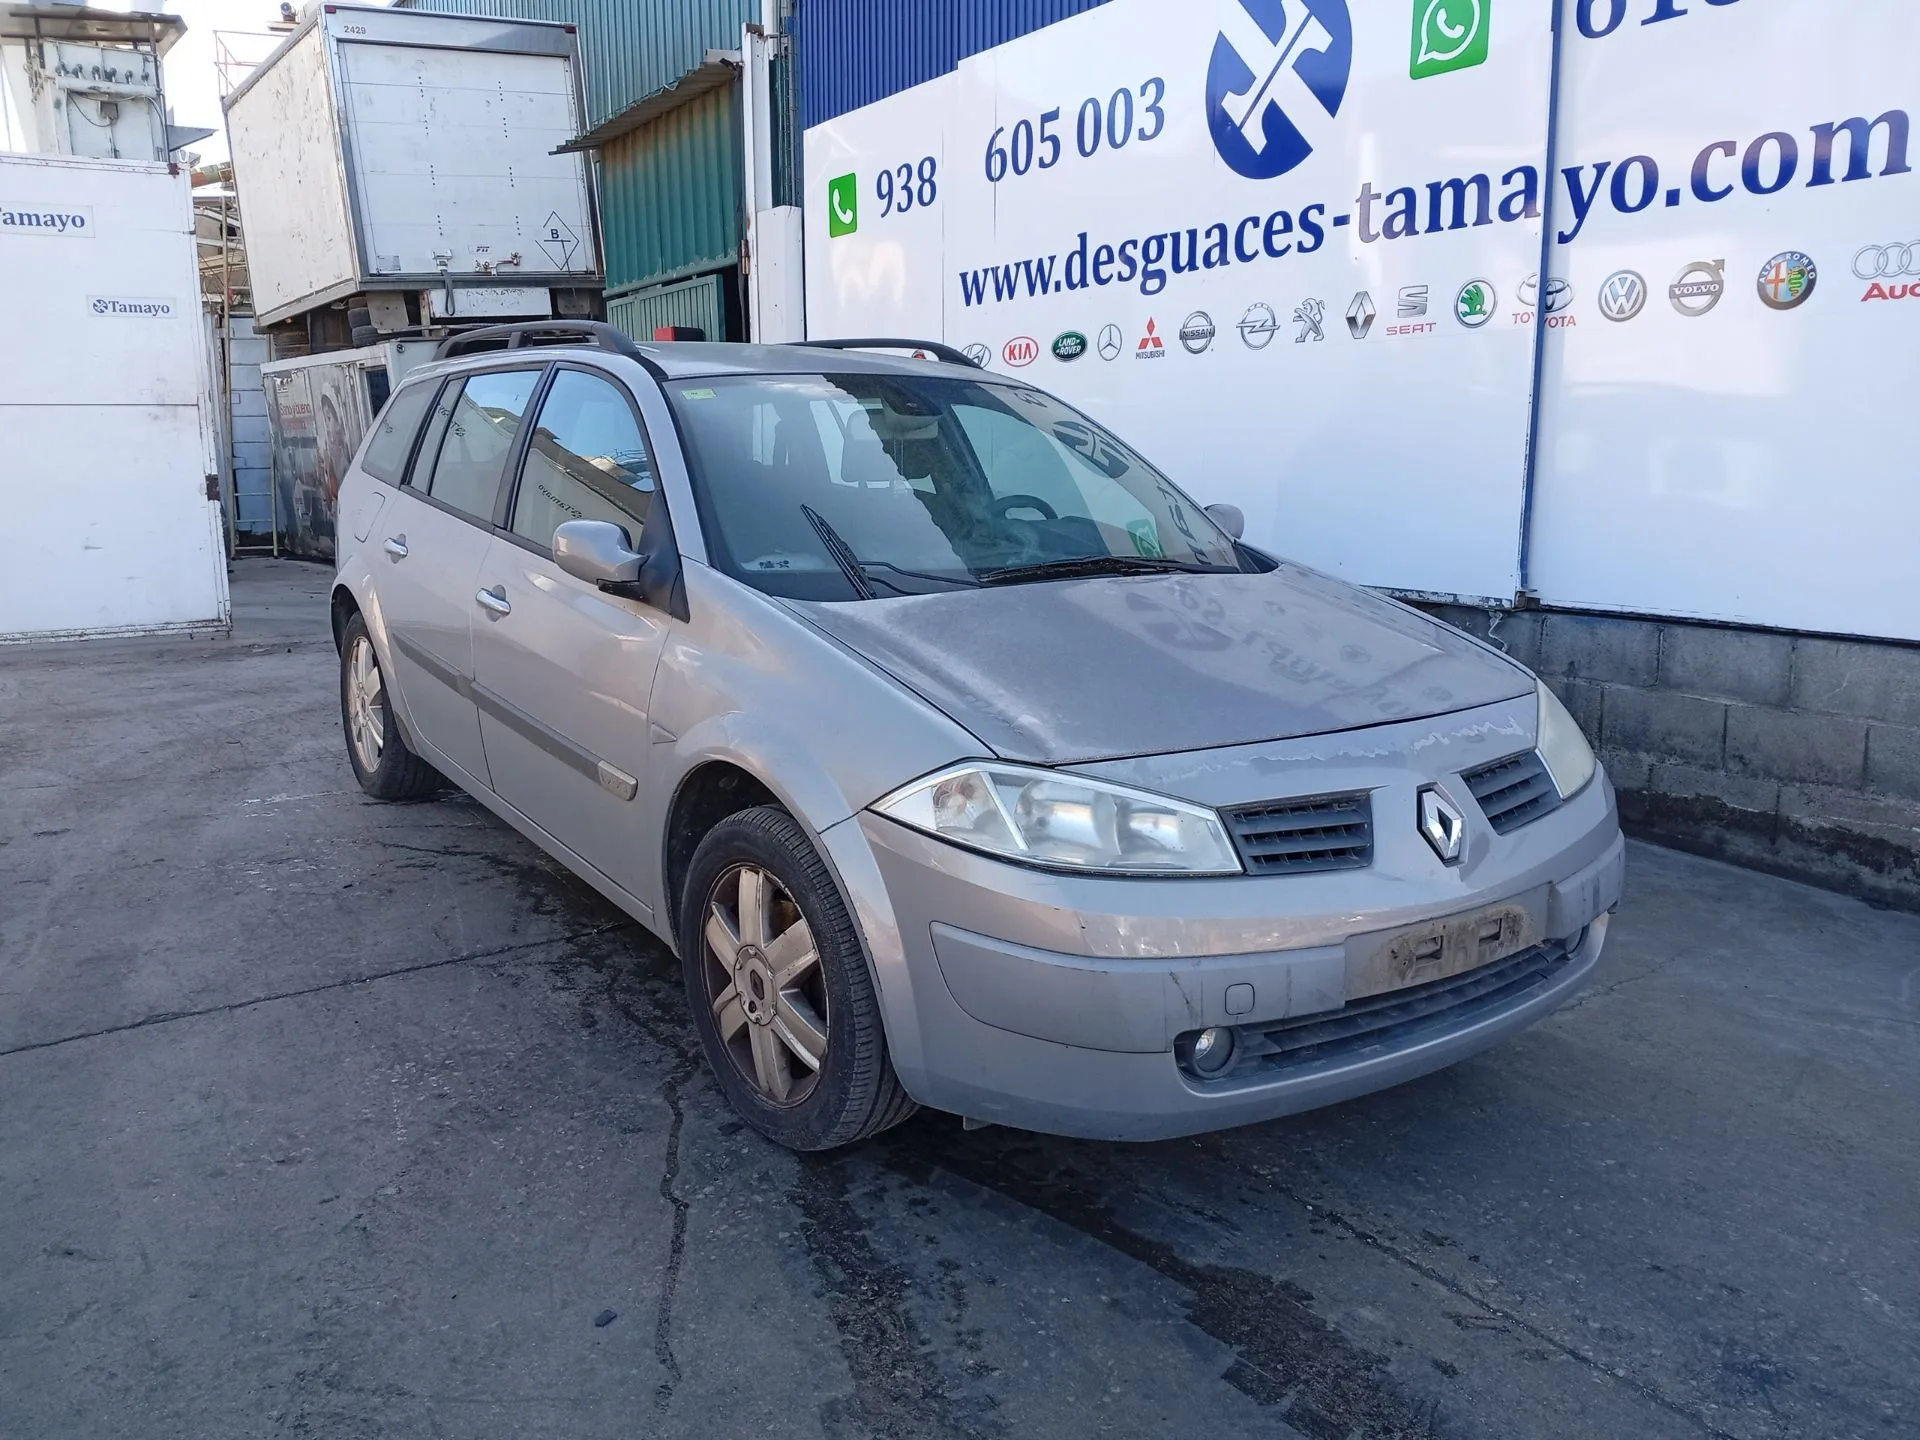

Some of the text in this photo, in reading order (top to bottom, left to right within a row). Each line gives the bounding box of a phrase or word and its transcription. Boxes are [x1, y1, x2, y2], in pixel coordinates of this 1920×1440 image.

[343, 25, 367, 35] 2429
[876, 76, 1165, 218] 938 605 003
[0, 207, 86, 232] amayo
[1785, 253, 1816, 280] ROMEO
[1672, 283, 1720, 295] VOLVO
[108, 300, 170, 317] Tamayo
[1182, 328, 1212, 338] NISSAN
[1386, 321, 1437, 336] SEAT
[1058, 337, 1077, 348] LAND
[1008, 343, 1033, 361] KIA
[1059, 345, 1082, 356] ROVER
[1135, 350, 1165, 360] MITSUBISHI
